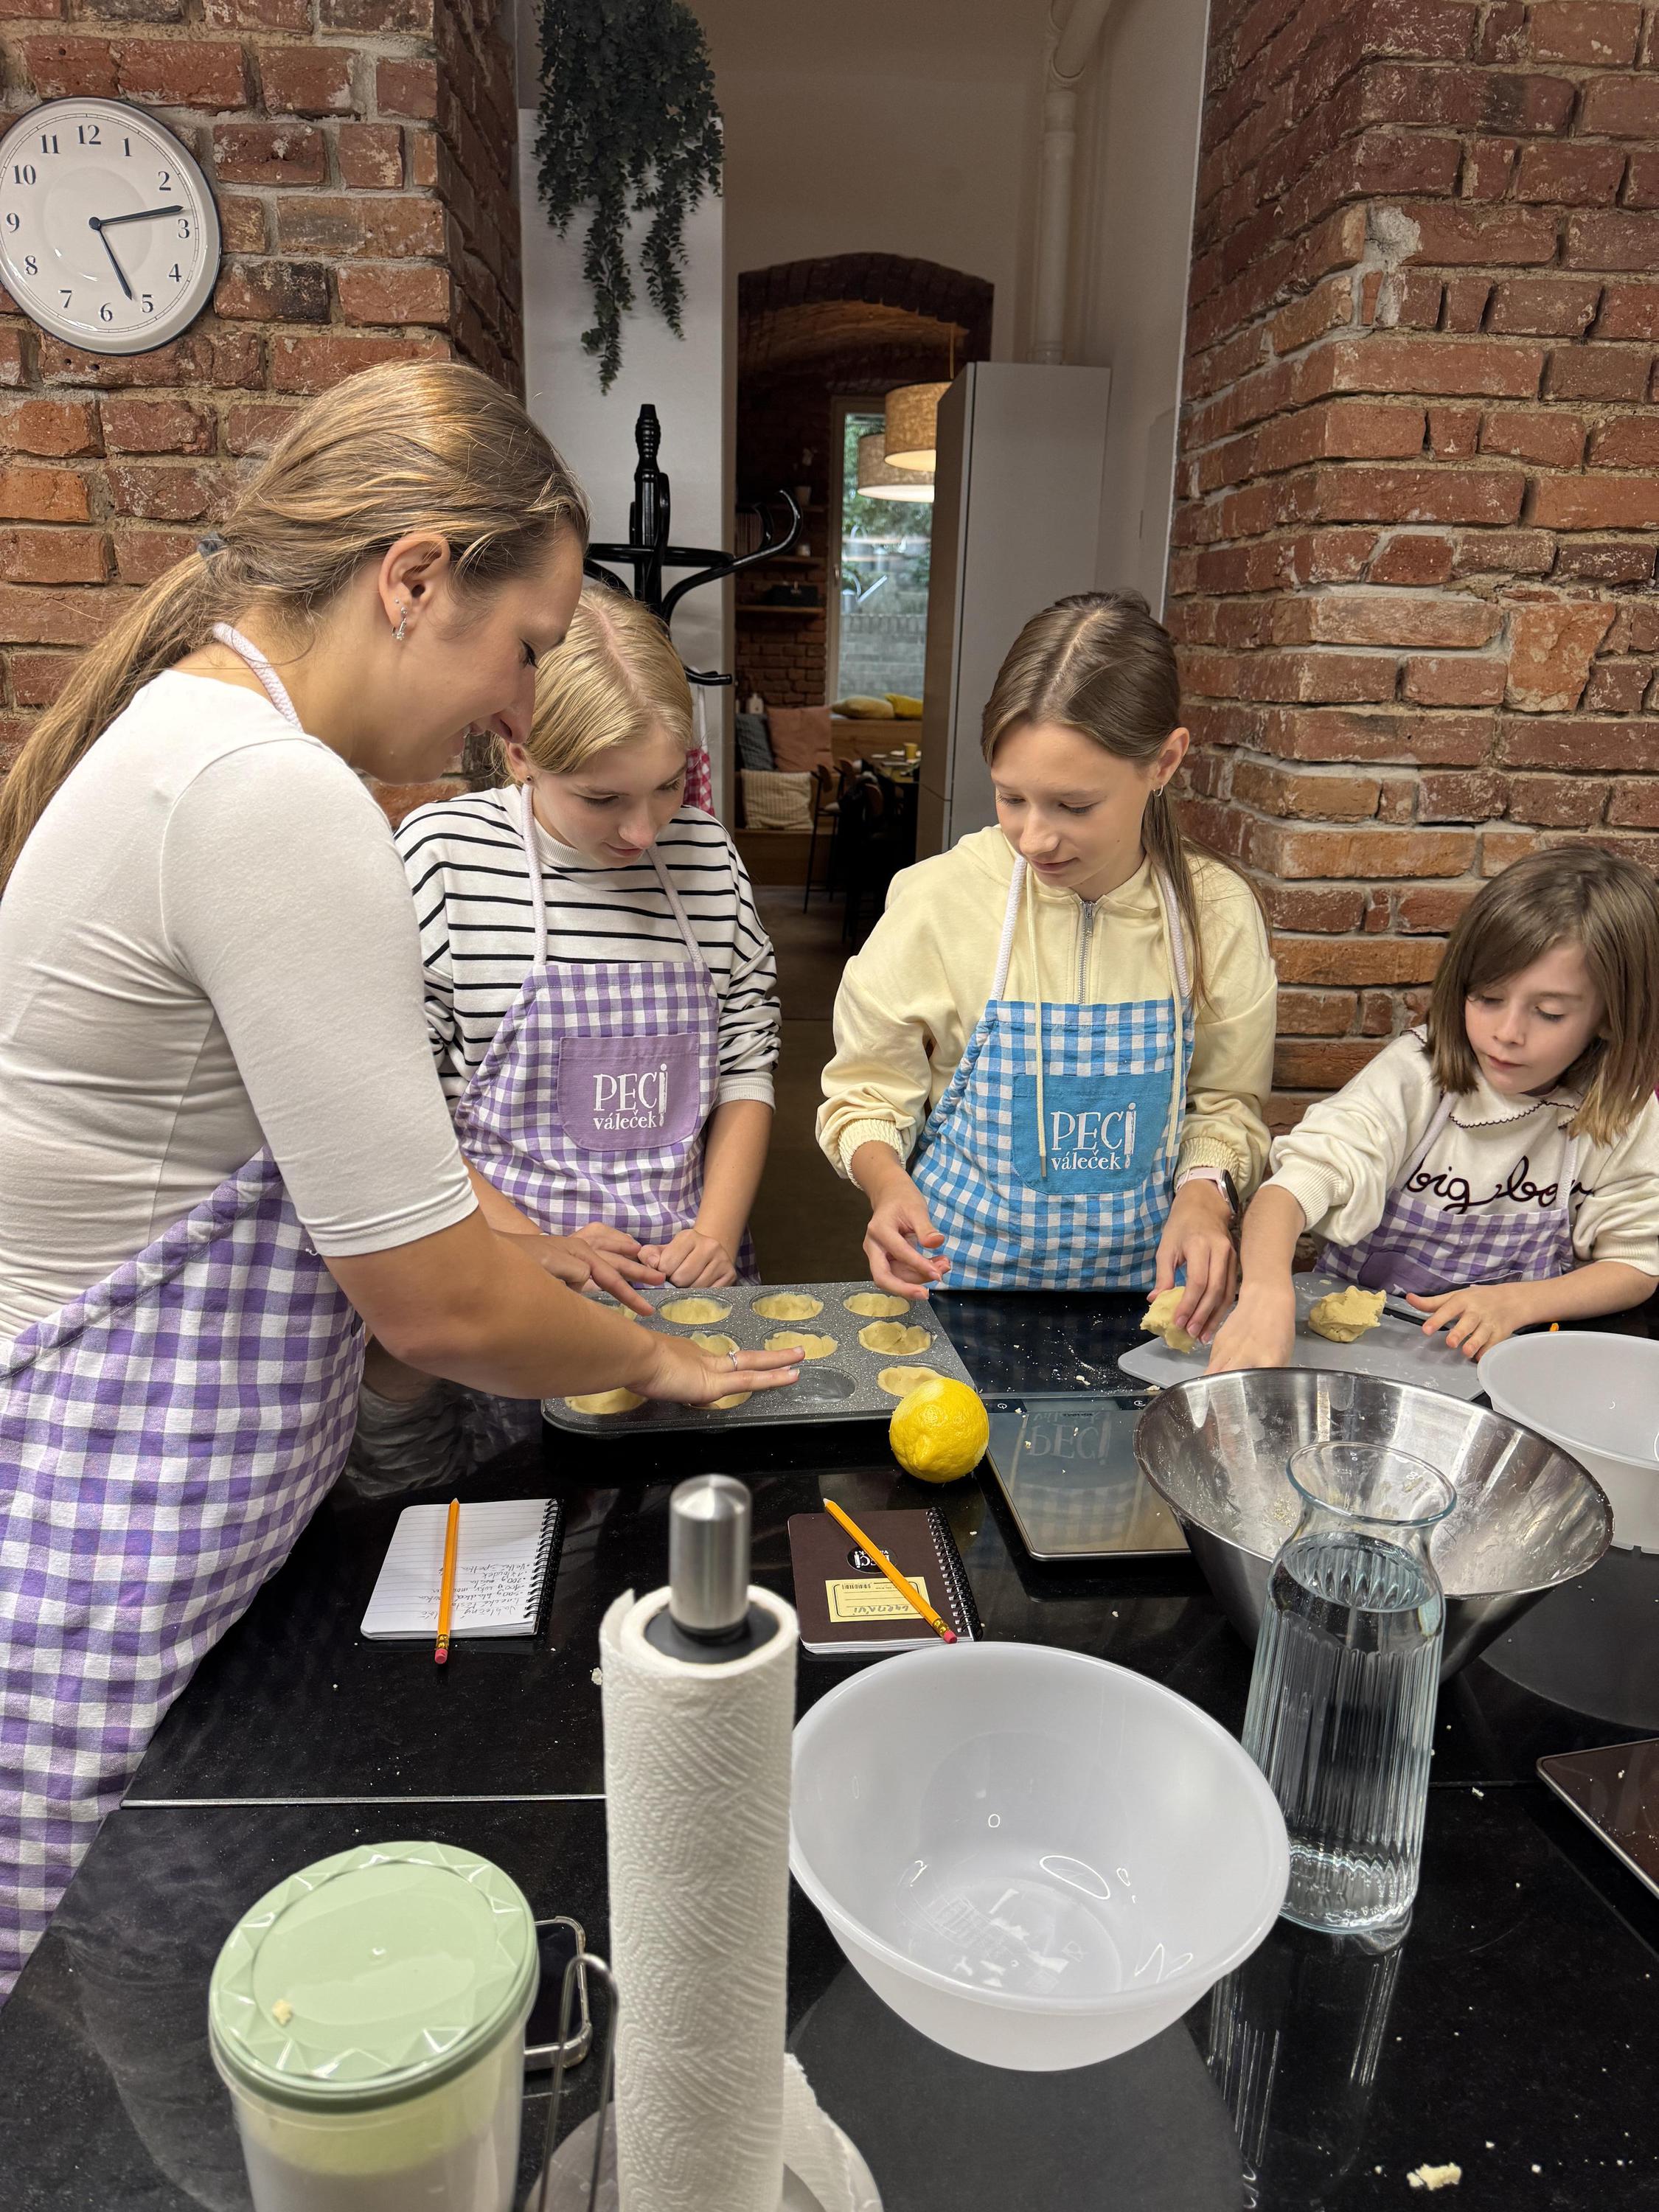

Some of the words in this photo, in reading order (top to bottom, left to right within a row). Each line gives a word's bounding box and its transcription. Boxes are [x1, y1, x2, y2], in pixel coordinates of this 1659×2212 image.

[41, 134, 60, 154] 11
[77, 125, 101, 145] 12
[123, 137, 132, 157] 1
[13, 164, 36, 184] 10
[158, 171, 171, 191] 2
[6, 212, 20, 233] 9
[178, 219, 190, 239] 3
[24, 255, 38, 275] 8
[168, 263, 182, 282] 4
[58, 289, 72, 308] 7
[141, 294, 154, 313] 5
[100, 302, 113, 321] 6
[593, 1110, 657, 1130] váleček
[1051, 1150, 1121, 1170] váleček
[1405, 1152, 1502, 1215] big
